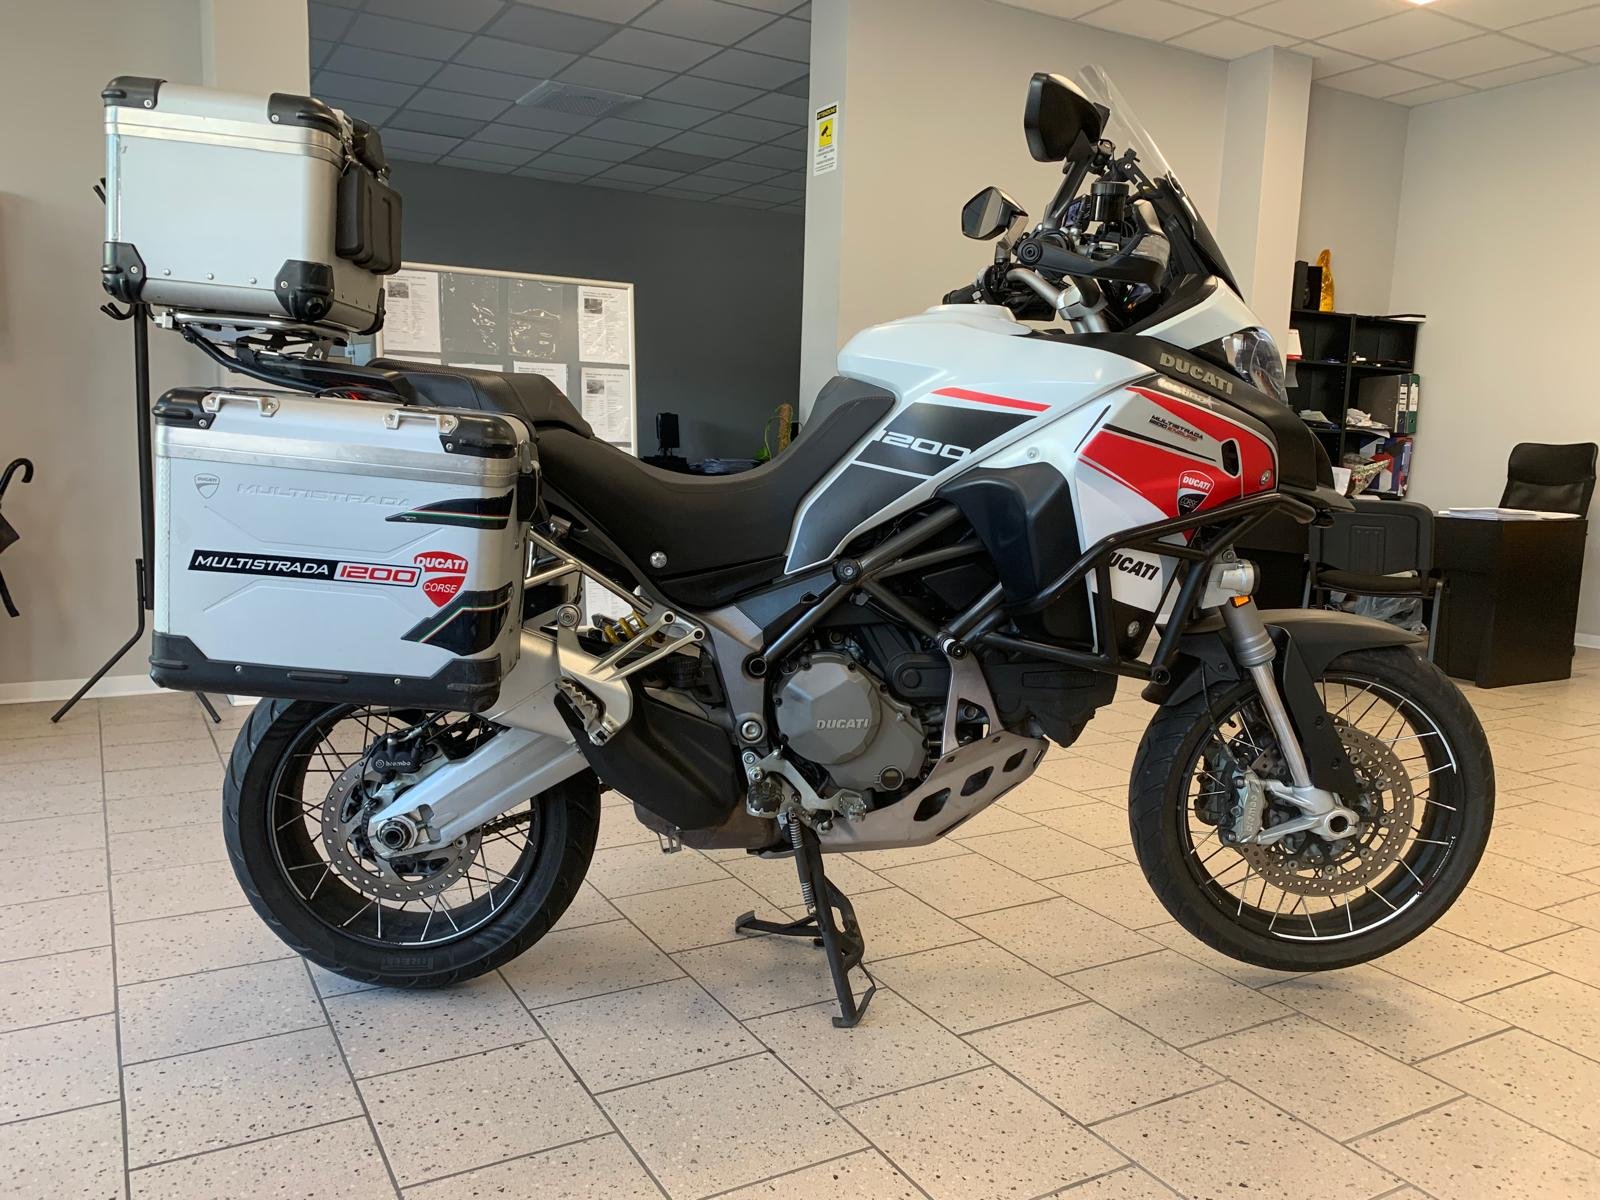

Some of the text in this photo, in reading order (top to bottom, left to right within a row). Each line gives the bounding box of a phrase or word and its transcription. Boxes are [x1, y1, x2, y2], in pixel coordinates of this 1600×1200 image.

[1160, 352, 1233, 395] DUCATI
[1151, 414, 1203, 440] MULTISTRADA
[872, 429, 972, 461] 1200
[236, 483, 410, 505] MULTISTRADA
[1182, 475, 1211, 490] DUCATI
[195, 555, 416, 583] MULTISTRADA 1200
[415, 556, 466, 570] DUCATI
[1109, 551, 1160, 581] UCATI
[423, 582, 458, 594] CORSE
[816, 719, 869, 729] DUCATI
